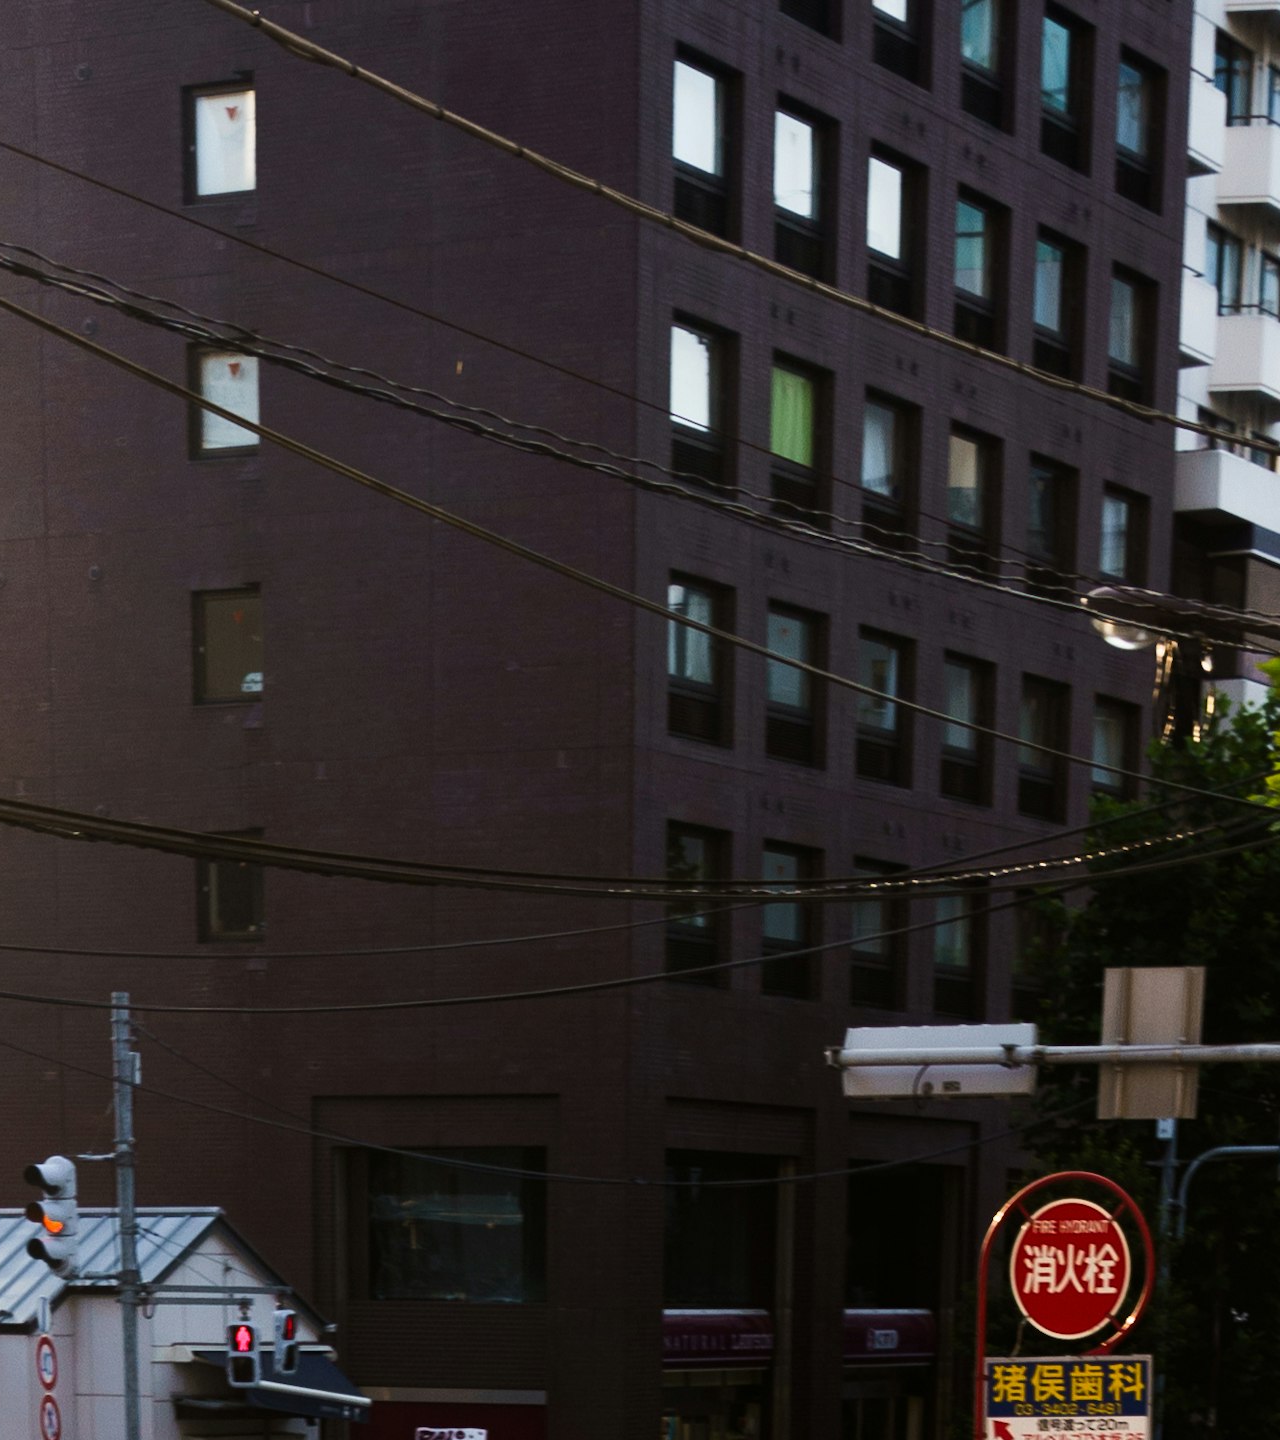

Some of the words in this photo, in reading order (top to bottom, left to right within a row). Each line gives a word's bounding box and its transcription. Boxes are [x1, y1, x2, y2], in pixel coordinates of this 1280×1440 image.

[1032, 1220, 1056, 1234] FIRE
[1022, 1242, 1120, 1294] 消火栓
